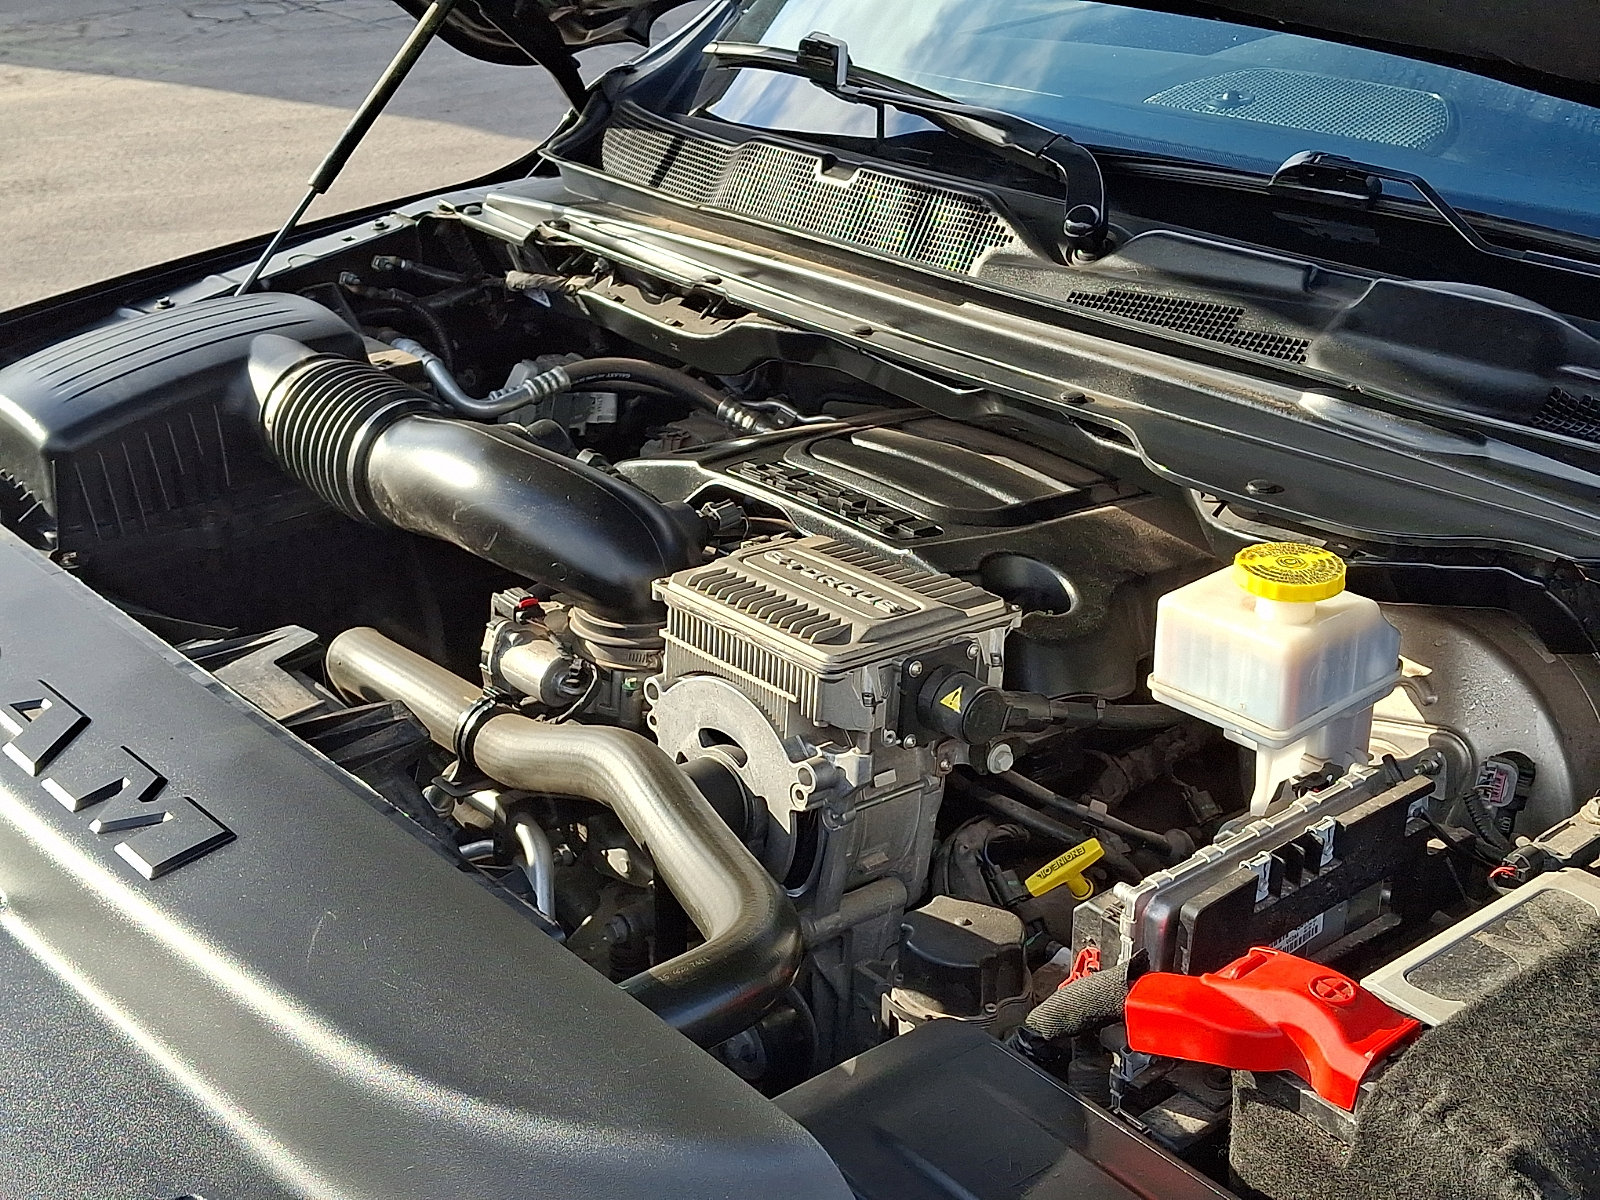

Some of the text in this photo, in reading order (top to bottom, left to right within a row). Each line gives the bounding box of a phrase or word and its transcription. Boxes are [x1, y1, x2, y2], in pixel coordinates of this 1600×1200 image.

[0, 679, 237, 880] AM
[1036, 846, 1086, 879] ENGINE OIL
